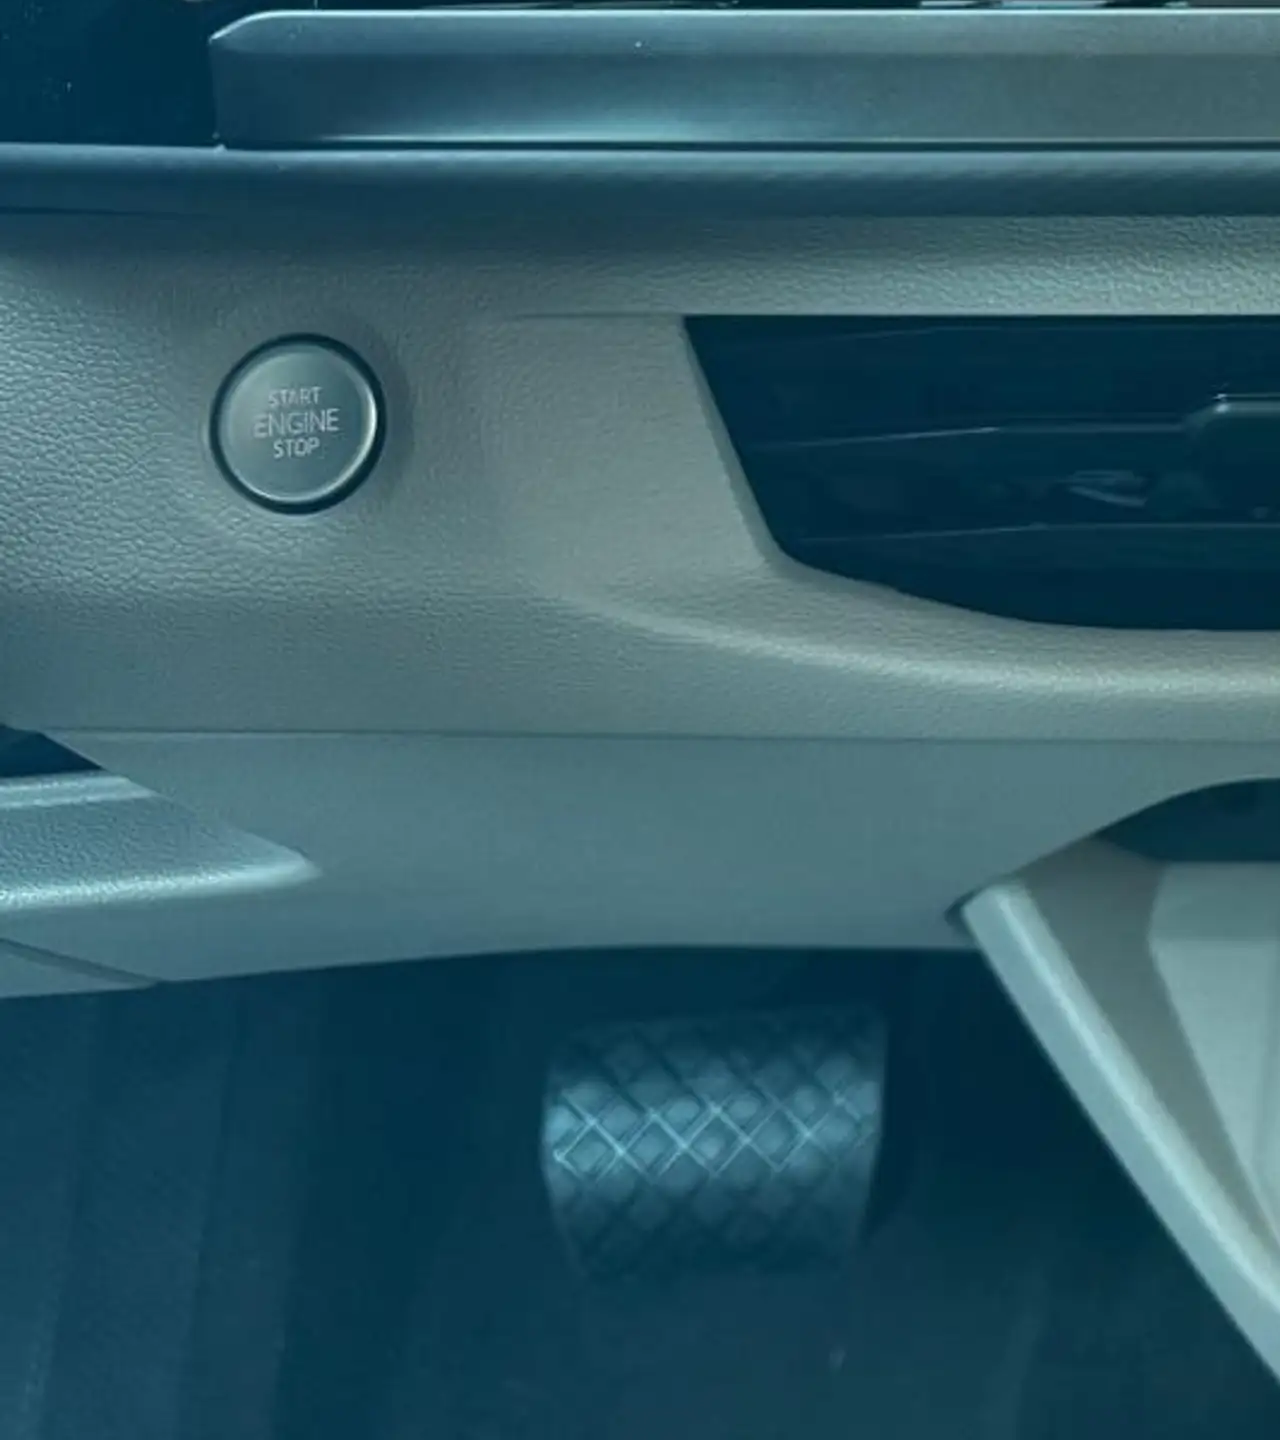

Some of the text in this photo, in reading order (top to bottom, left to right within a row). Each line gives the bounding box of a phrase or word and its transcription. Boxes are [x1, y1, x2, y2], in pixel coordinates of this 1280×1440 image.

[268, 386, 321, 407] START
[253, 408, 340, 439] ENGINE
[273, 437, 320, 459] STOP
